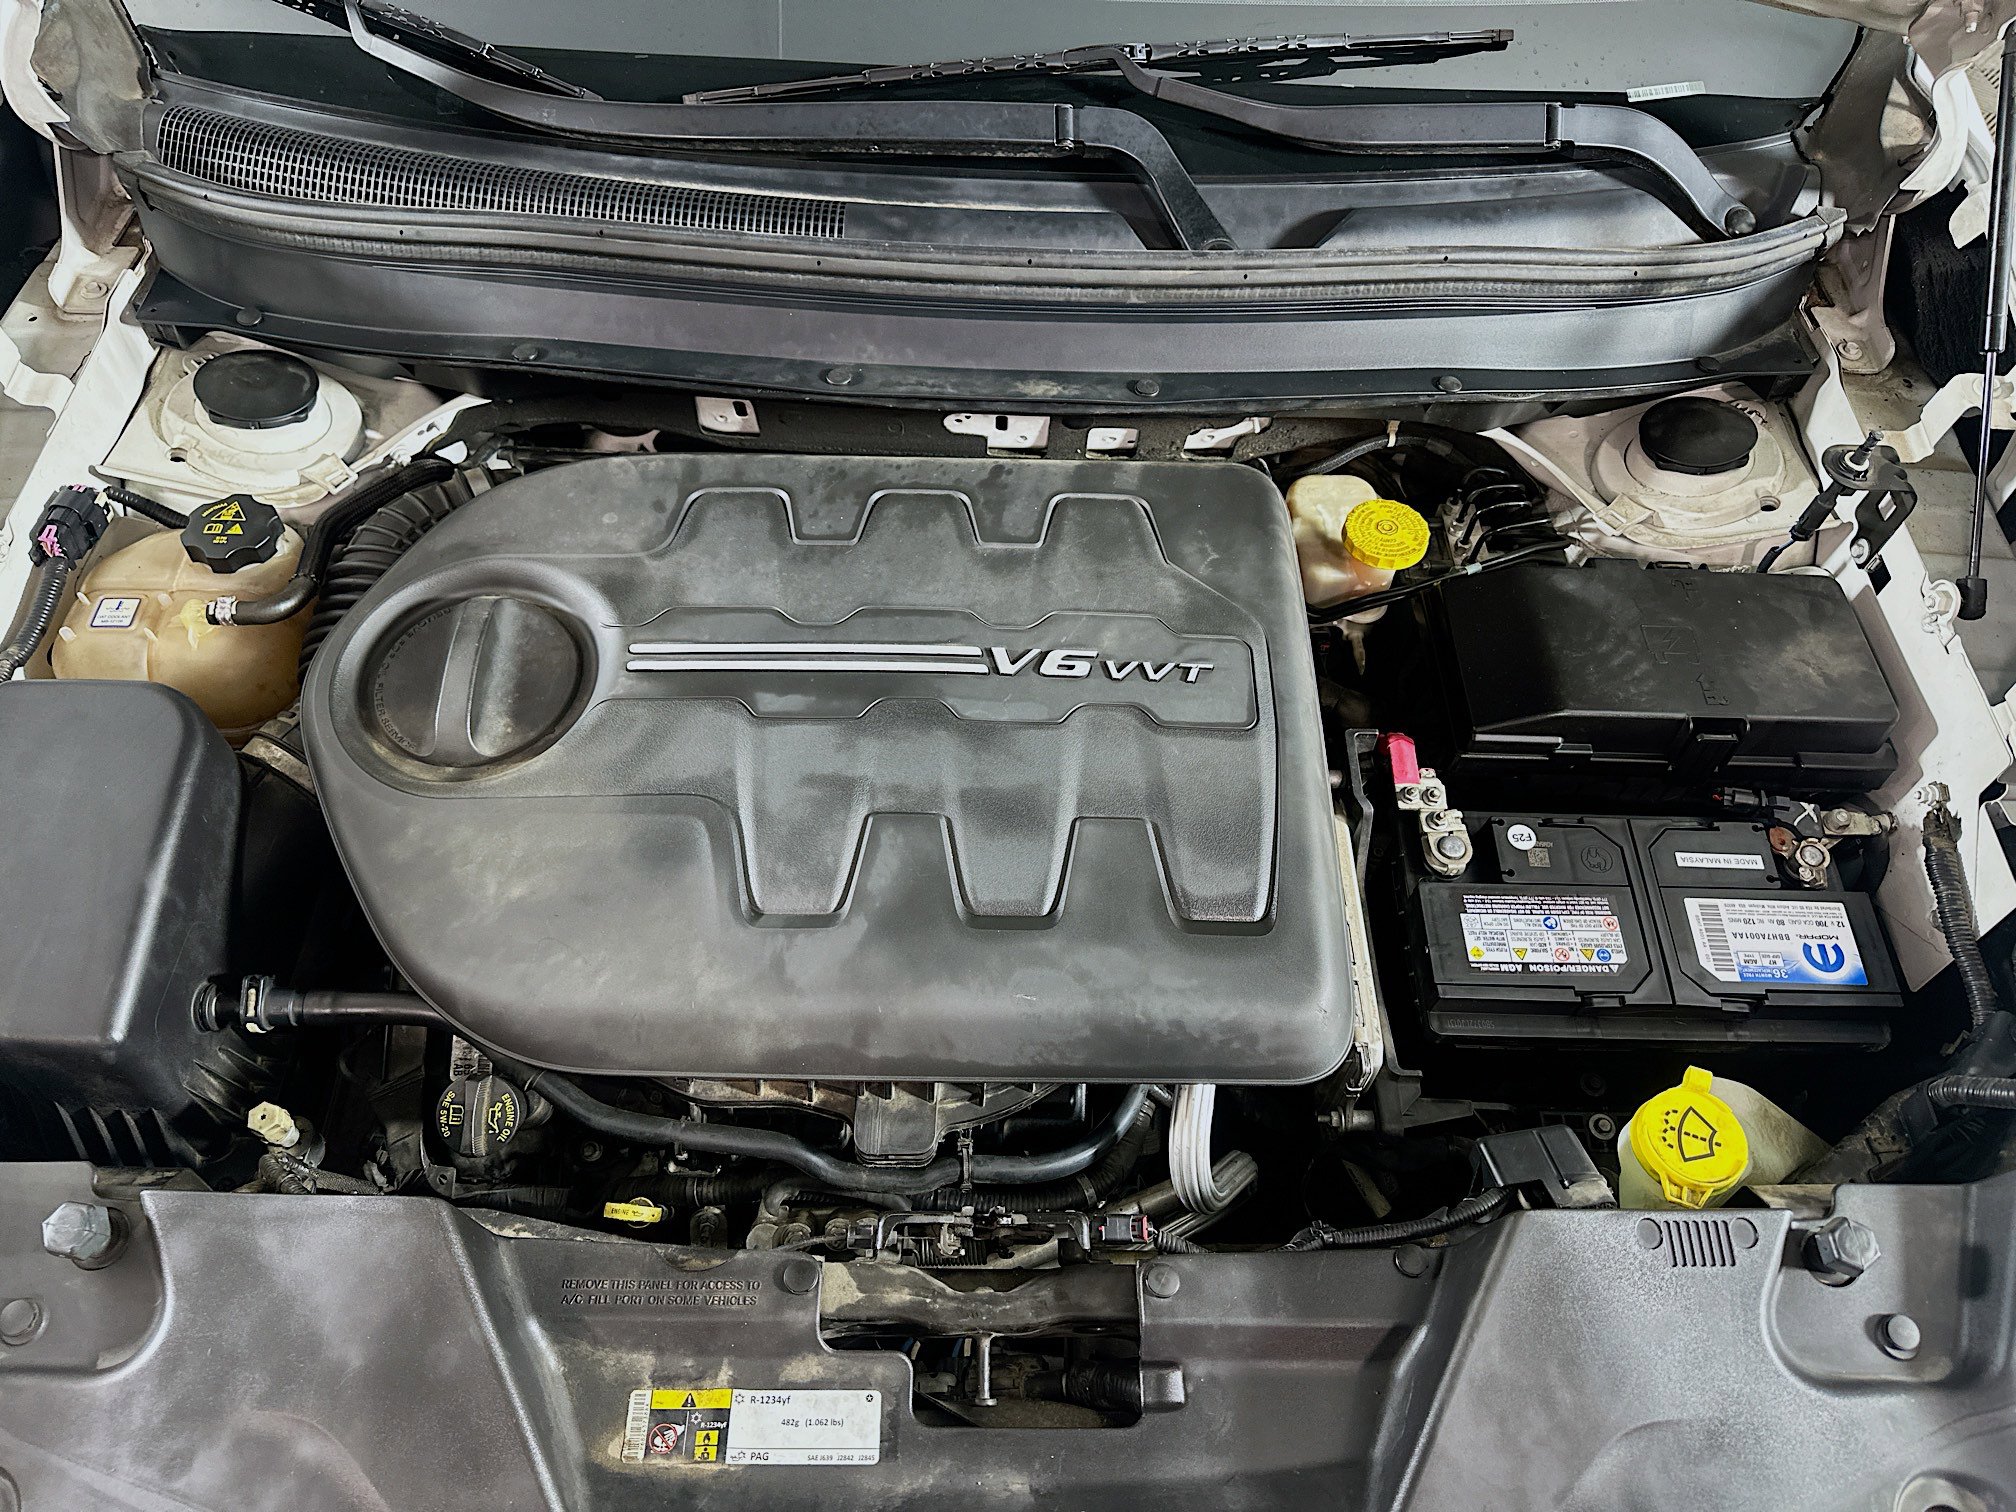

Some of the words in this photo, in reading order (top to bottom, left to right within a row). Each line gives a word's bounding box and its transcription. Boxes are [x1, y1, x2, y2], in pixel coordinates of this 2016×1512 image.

[988, 647, 1099, 679] V6
[1104, 660, 1214, 683] VVT
[1512, 833, 1532, 843] F25
[1680, 856, 1722, 864] MALAYSIA
[1500, 963, 1523, 972] AGM
[1772, 968, 1788, 978] 36
[442, 1090, 456, 1108] SAE
[500, 1093, 515, 1128] ENGINE
[496, 1128, 511, 1142] OIL
[560, 1279, 609, 1290] REMOVE
[610, 1279, 636, 1290] THIS
[637, 1280, 674, 1290] PANEL
[675, 1280, 699, 1290] FOR
[700, 1280, 745, 1290] ACCESS
[748, 1280, 761, 1290] TO
[560, 1294, 585, 1306] A/C
[588, 1294, 612, 1305] FILL
[614, 1294, 645, 1305] PORT
[648, 1294, 668, 1306] ON
[669, 1294, 700, 1306] SOME
[704, 1295, 758, 1306] VEHICLES
[750, 1396, 791, 1406] R-1234yf
[780, 1418, 800, 1428] 482g
[804, 1418, 829, 1428] (1.062
[830, 1418, 844, 1428] lbs)
[750, 1452, 770, 1462] PAG
